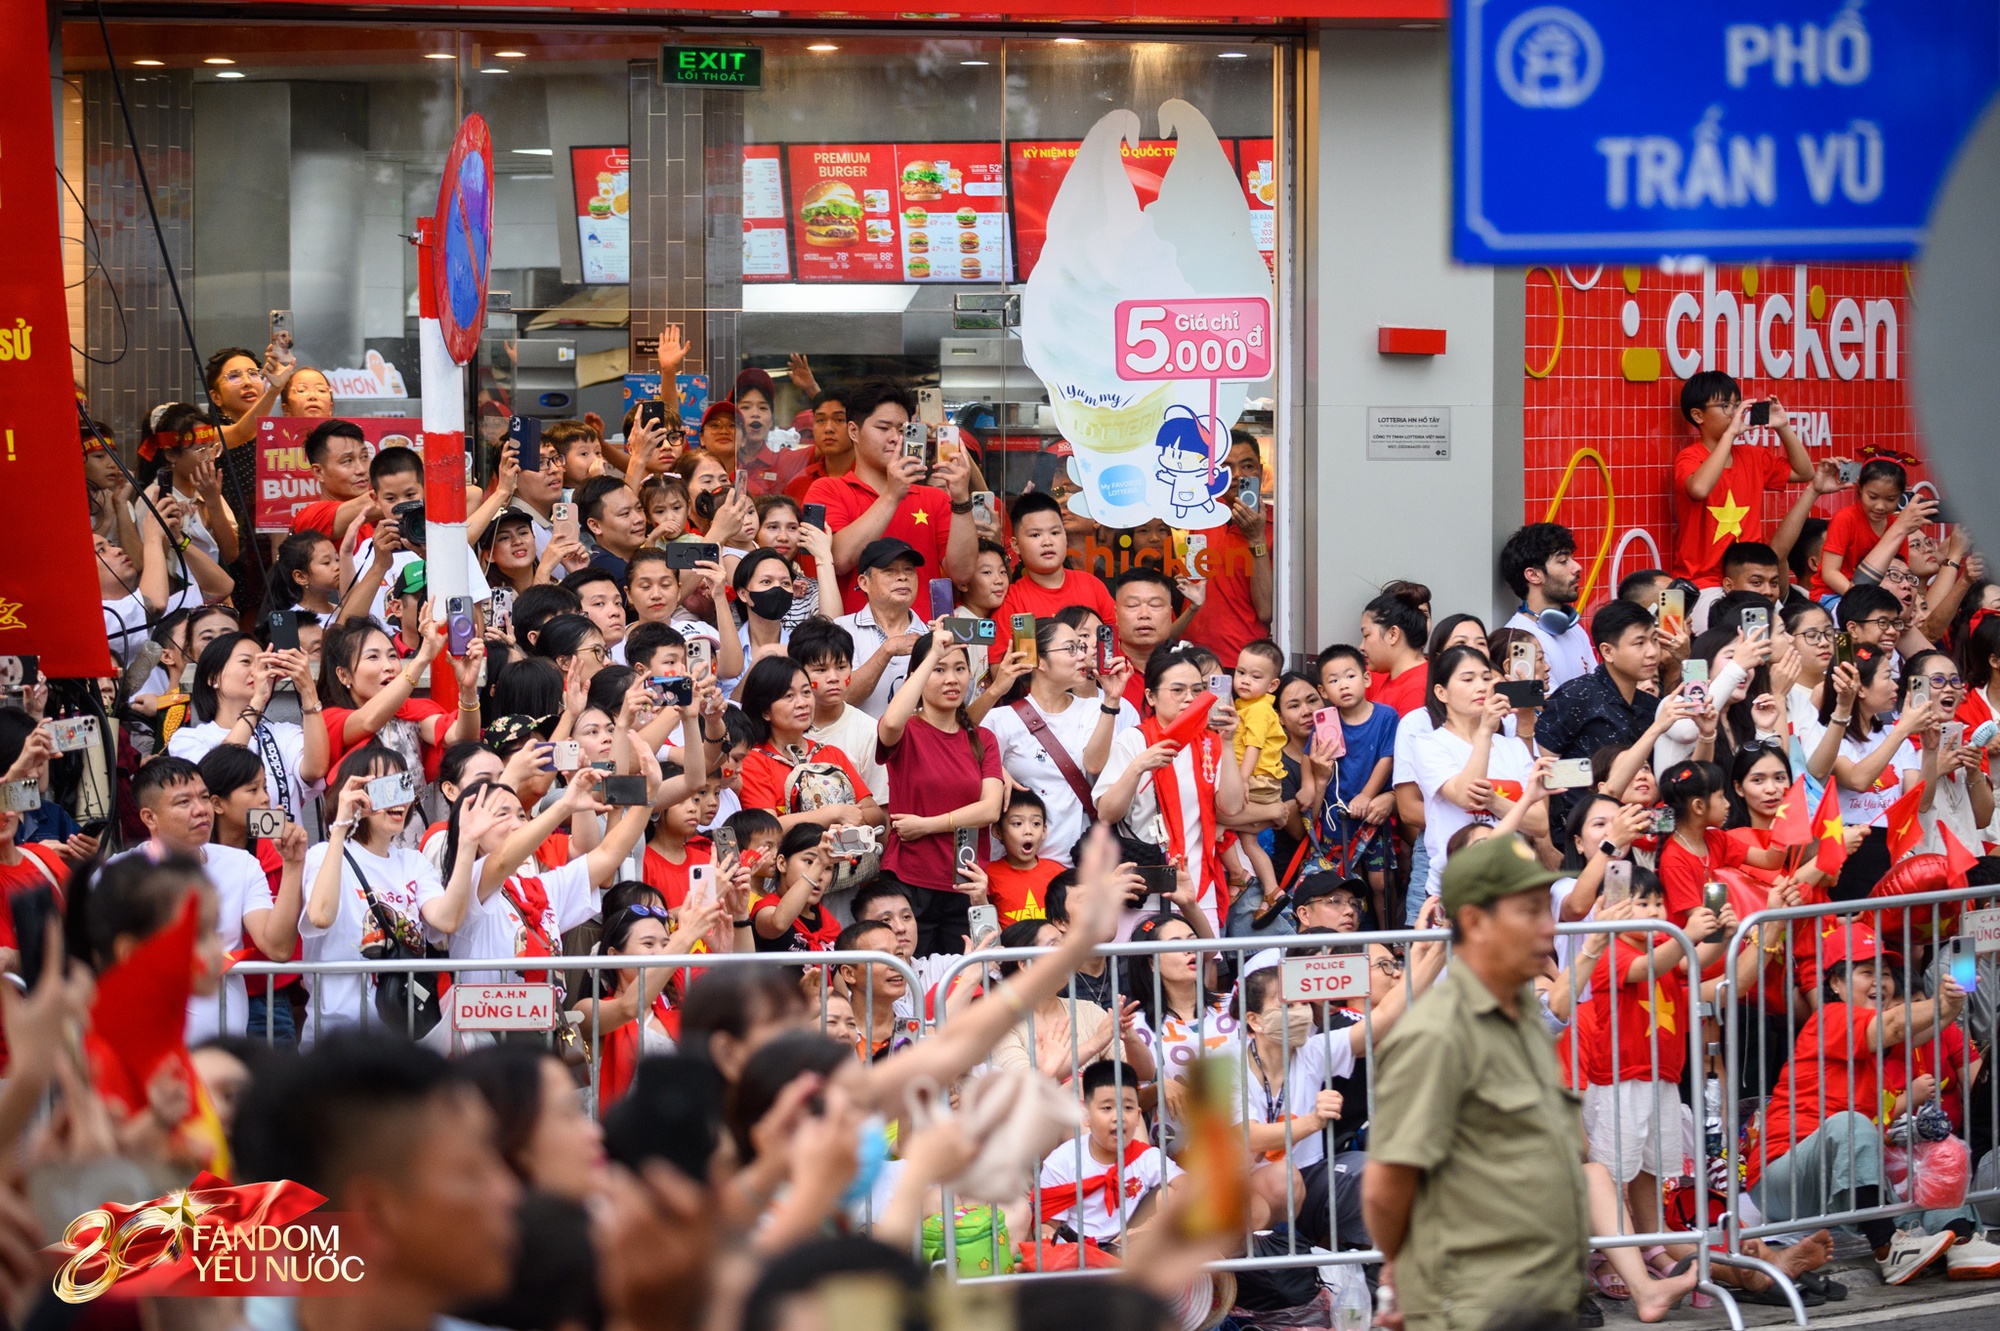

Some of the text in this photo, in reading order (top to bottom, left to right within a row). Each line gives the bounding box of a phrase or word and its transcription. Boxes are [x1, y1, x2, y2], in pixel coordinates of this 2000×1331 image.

[1725, 0, 1872, 87] PHỐ
[679, 51, 746, 70] EXIT
[702, 71, 745, 82] THOÁT
[814, 152, 871, 164] PREMIUM
[1039, 146, 1067, 160] NIỆM
[1120, 144, 1130, 157] Ổ
[1131, 144, 1161, 158] QUỐC
[1162, 148, 1177, 158] TR
[1596, 104, 1885, 209] TRẤN VŨ
[819, 166, 868, 177] BURGER
[1175, 310, 1240, 331] Giá chỉ
[1666, 264, 1898, 381] chicken
[342, 377, 377, 395] HƠN
[6, 429, 16, 461] !
[264, 446, 312, 472] THU
[1305, 960, 1346, 971] POLICE
[1300, 975, 1352, 992] STOP
[482, 990, 527, 999] C.A.H.N
[461, 1000, 547, 1021] DỪNG LẠI
